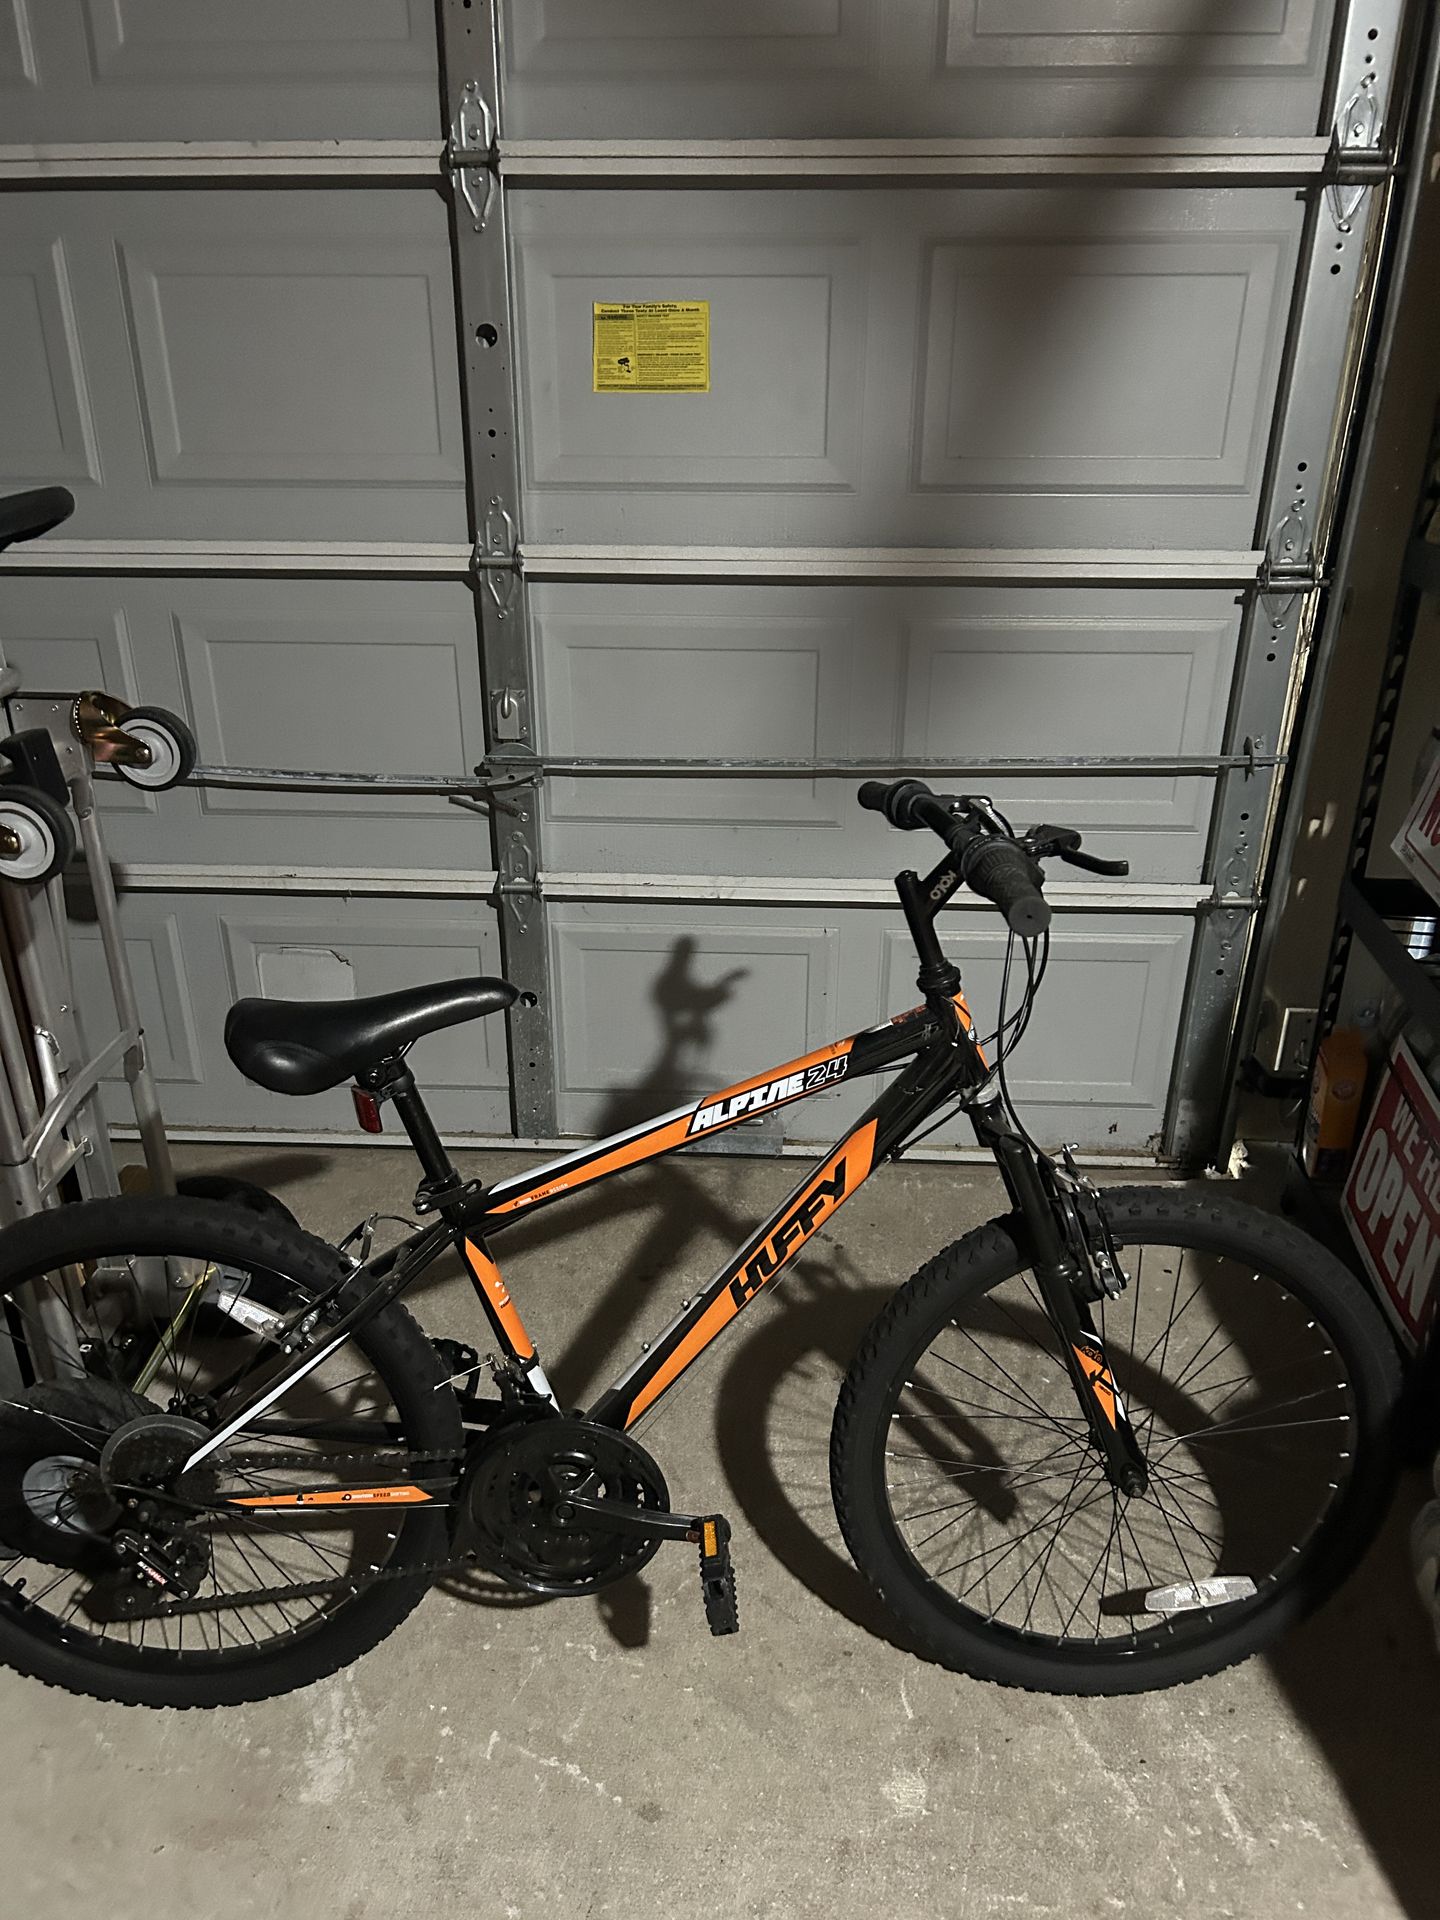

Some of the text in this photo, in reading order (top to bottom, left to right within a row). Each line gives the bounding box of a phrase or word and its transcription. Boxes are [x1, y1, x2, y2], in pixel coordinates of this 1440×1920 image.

[930, 869, 957, 900] KOLO
[691, 1055, 848, 1133] ALPINE 24
[729, 1156, 847, 1309] HUFFY
[1355, 1127, 1440, 1323] OPEN
